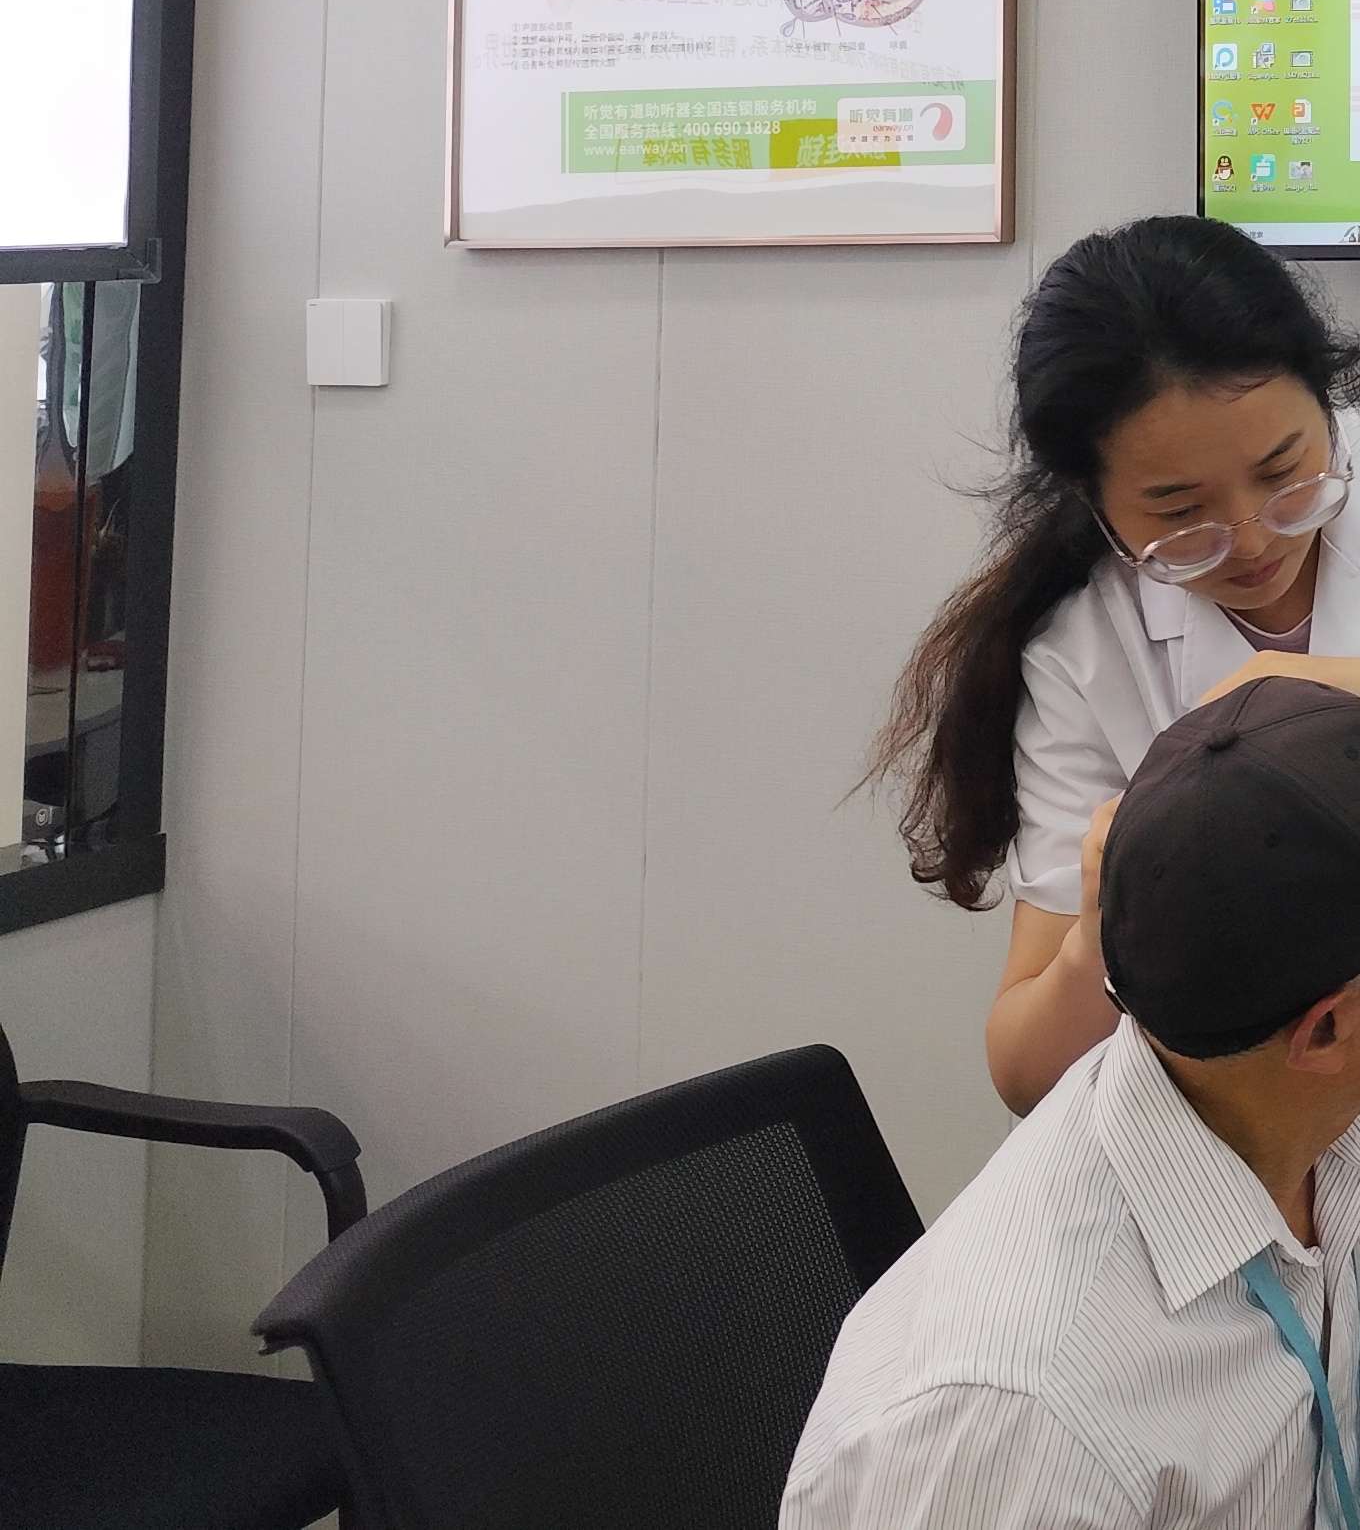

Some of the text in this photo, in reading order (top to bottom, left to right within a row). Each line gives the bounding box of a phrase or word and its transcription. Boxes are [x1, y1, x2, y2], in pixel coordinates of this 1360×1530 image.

[584, 98, 818, 121] 听觉有道助听器全国连锁服务机构
[683, 122, 713, 137] 400
[714, 121, 743, 137] 690
[744, 120, 782, 136] 1828
